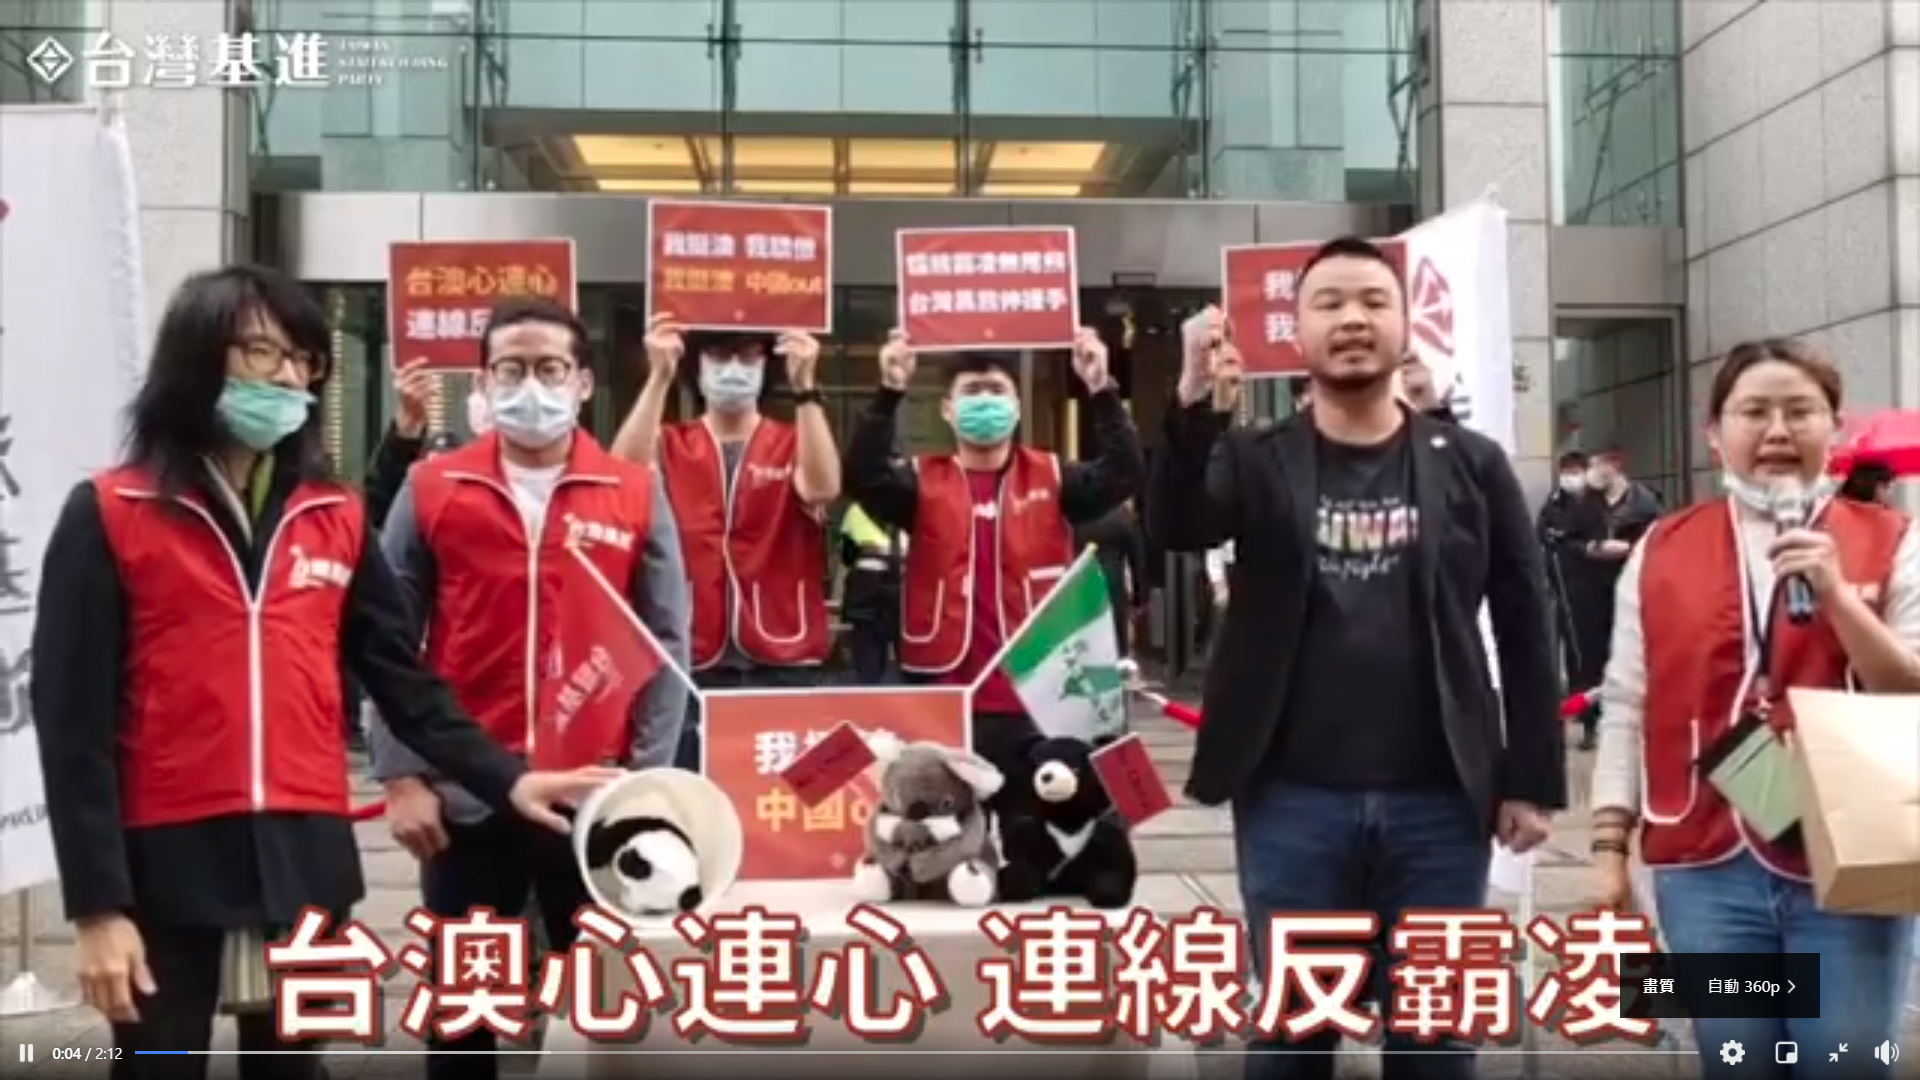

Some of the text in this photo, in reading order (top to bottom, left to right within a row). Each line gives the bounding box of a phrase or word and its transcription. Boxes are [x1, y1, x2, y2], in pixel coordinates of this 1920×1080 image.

[405, 264, 559, 297] 台澳心連心
[1264, 268, 1302, 301] 我
[1265, 311, 1299, 343] 我
